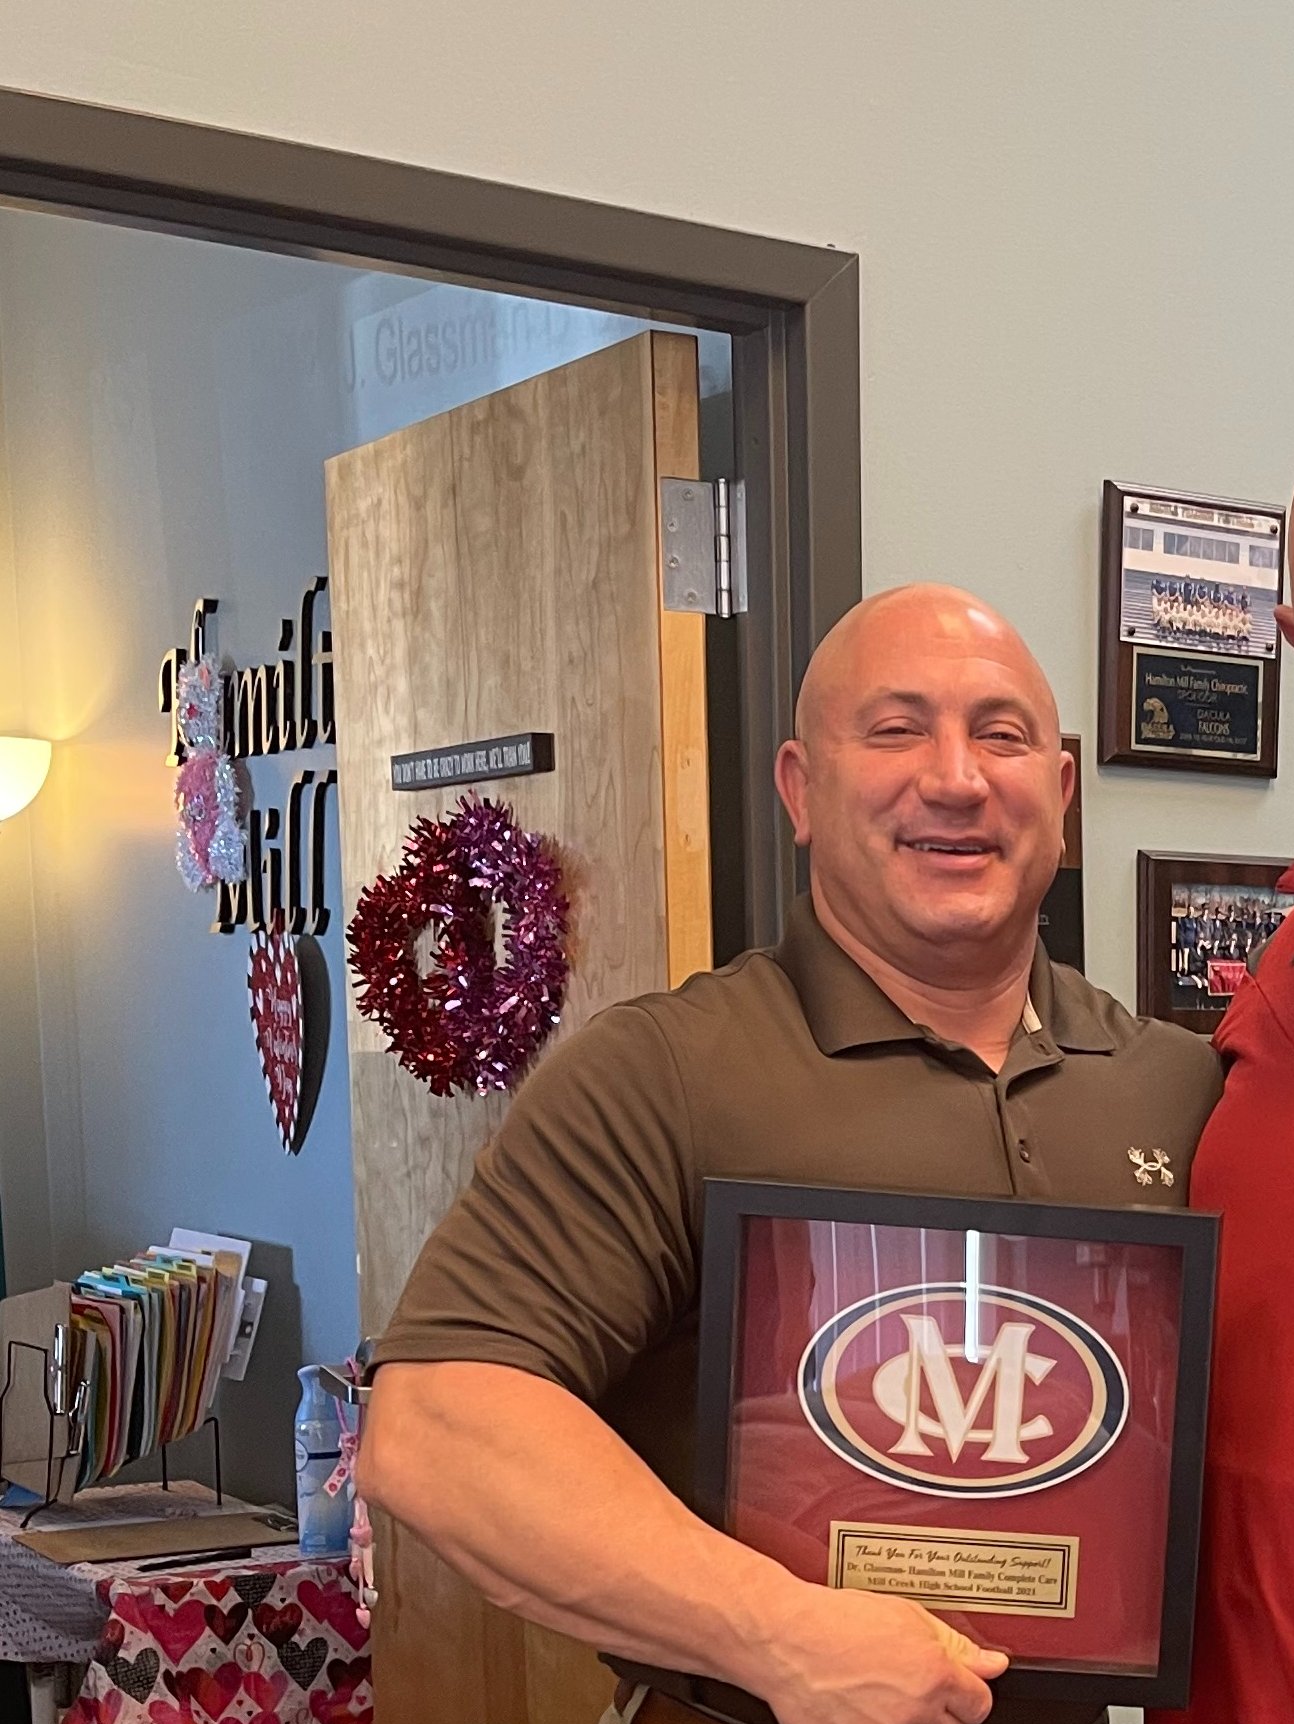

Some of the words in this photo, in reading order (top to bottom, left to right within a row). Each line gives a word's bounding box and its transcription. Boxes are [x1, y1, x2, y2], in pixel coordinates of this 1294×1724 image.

[855, 1545, 882, 1557] Thank
[886, 1547, 906, 1560] You
[908, 1548, 923, 1560] For
[926, 1550, 950, 1563] Your
[953, 1551, 1007, 1569] Outstanding
[1009, 1555, 1052, 1570] Support!
[847, 1562, 861, 1573] Dr.
[908, 1566, 946, 1577] Hamilton
[948, 1569, 966, 1579] Mill
[967, 1570, 995, 1583] Family
[997, 1572, 1036, 1584] Complete
[1037, 1574, 1058, 1585] Care
[867, 1576, 886, 1586] Mill
[888, 1578, 915, 1588] Creek
[919, 1580, 941, 1591] High
[943, 1581, 974, 1592] School
[976, 1584, 1014, 1595] Football
[1015, 1587, 1036, 1596] 2021
